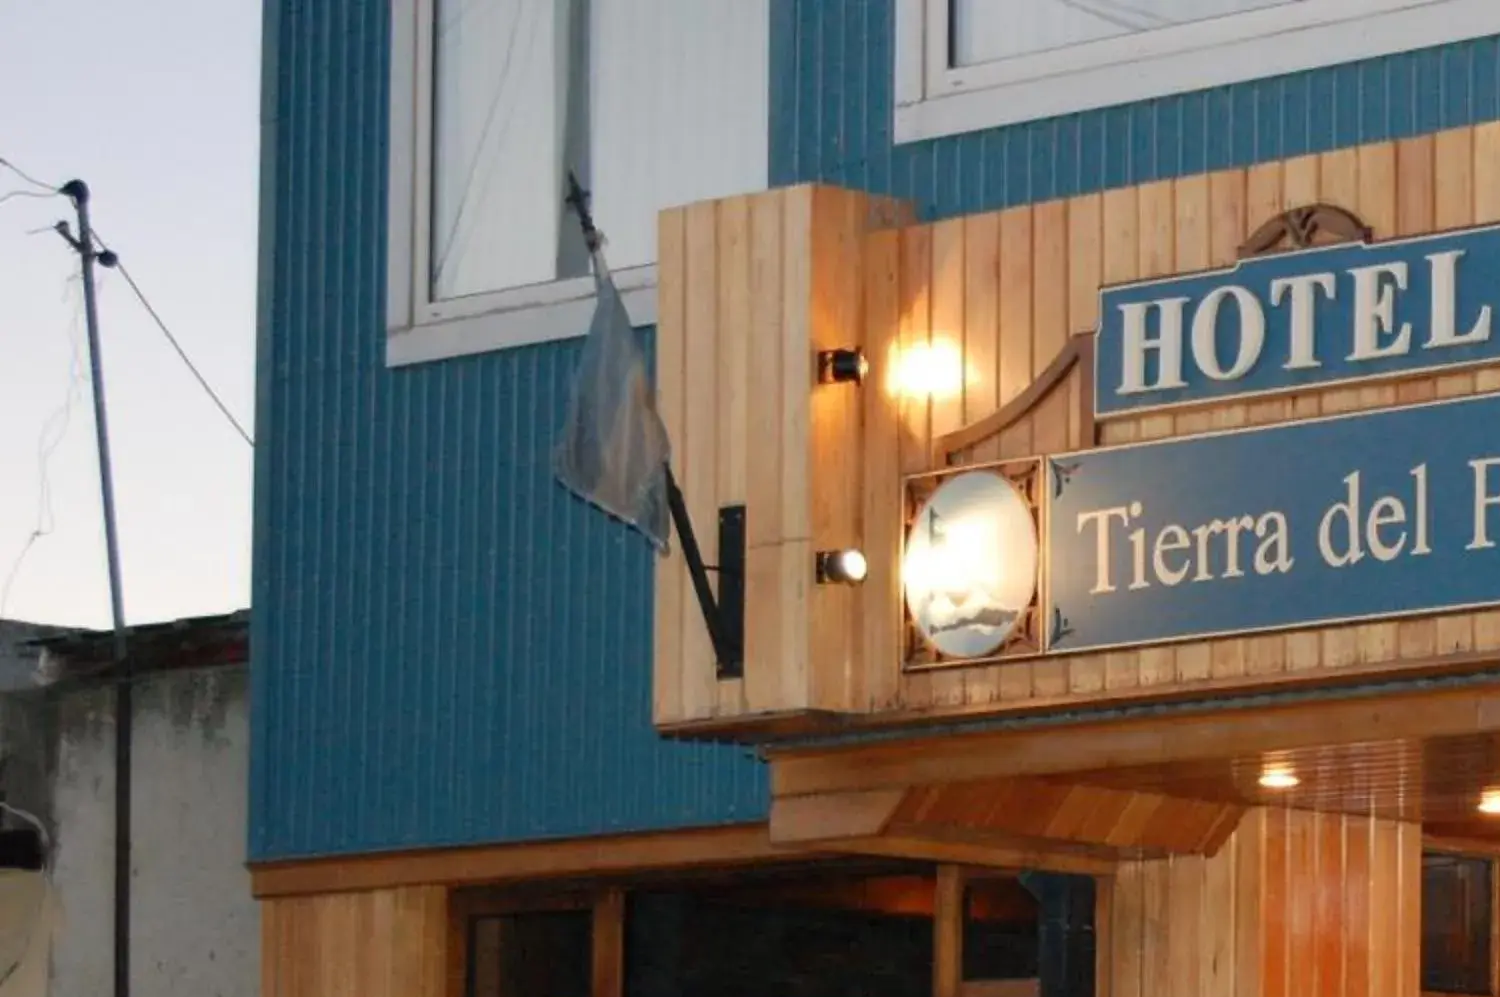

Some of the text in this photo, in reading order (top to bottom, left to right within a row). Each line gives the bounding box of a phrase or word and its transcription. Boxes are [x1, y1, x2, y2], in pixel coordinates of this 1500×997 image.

[1114, 249, 1492, 395] HOTEL
[1076, 501, 1294, 594] Tierra
[1318, 463, 1432, 568] del
